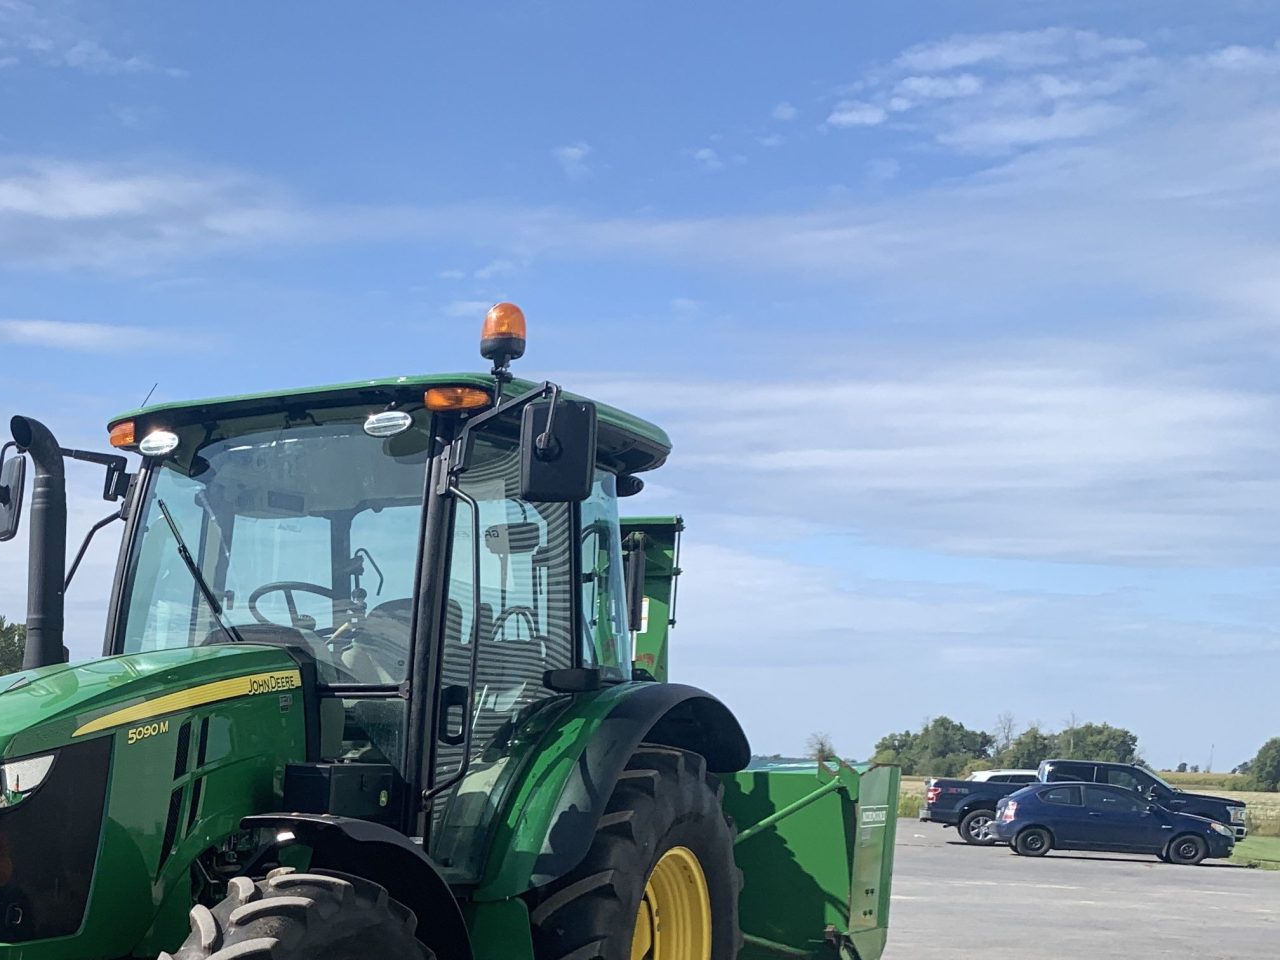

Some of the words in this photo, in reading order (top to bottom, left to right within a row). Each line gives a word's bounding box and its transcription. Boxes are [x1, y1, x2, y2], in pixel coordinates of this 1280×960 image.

[248, 678, 270, 693] JOHN
[270, 675, 294, 689] DEERE
[127, 723, 159, 745] 5090
